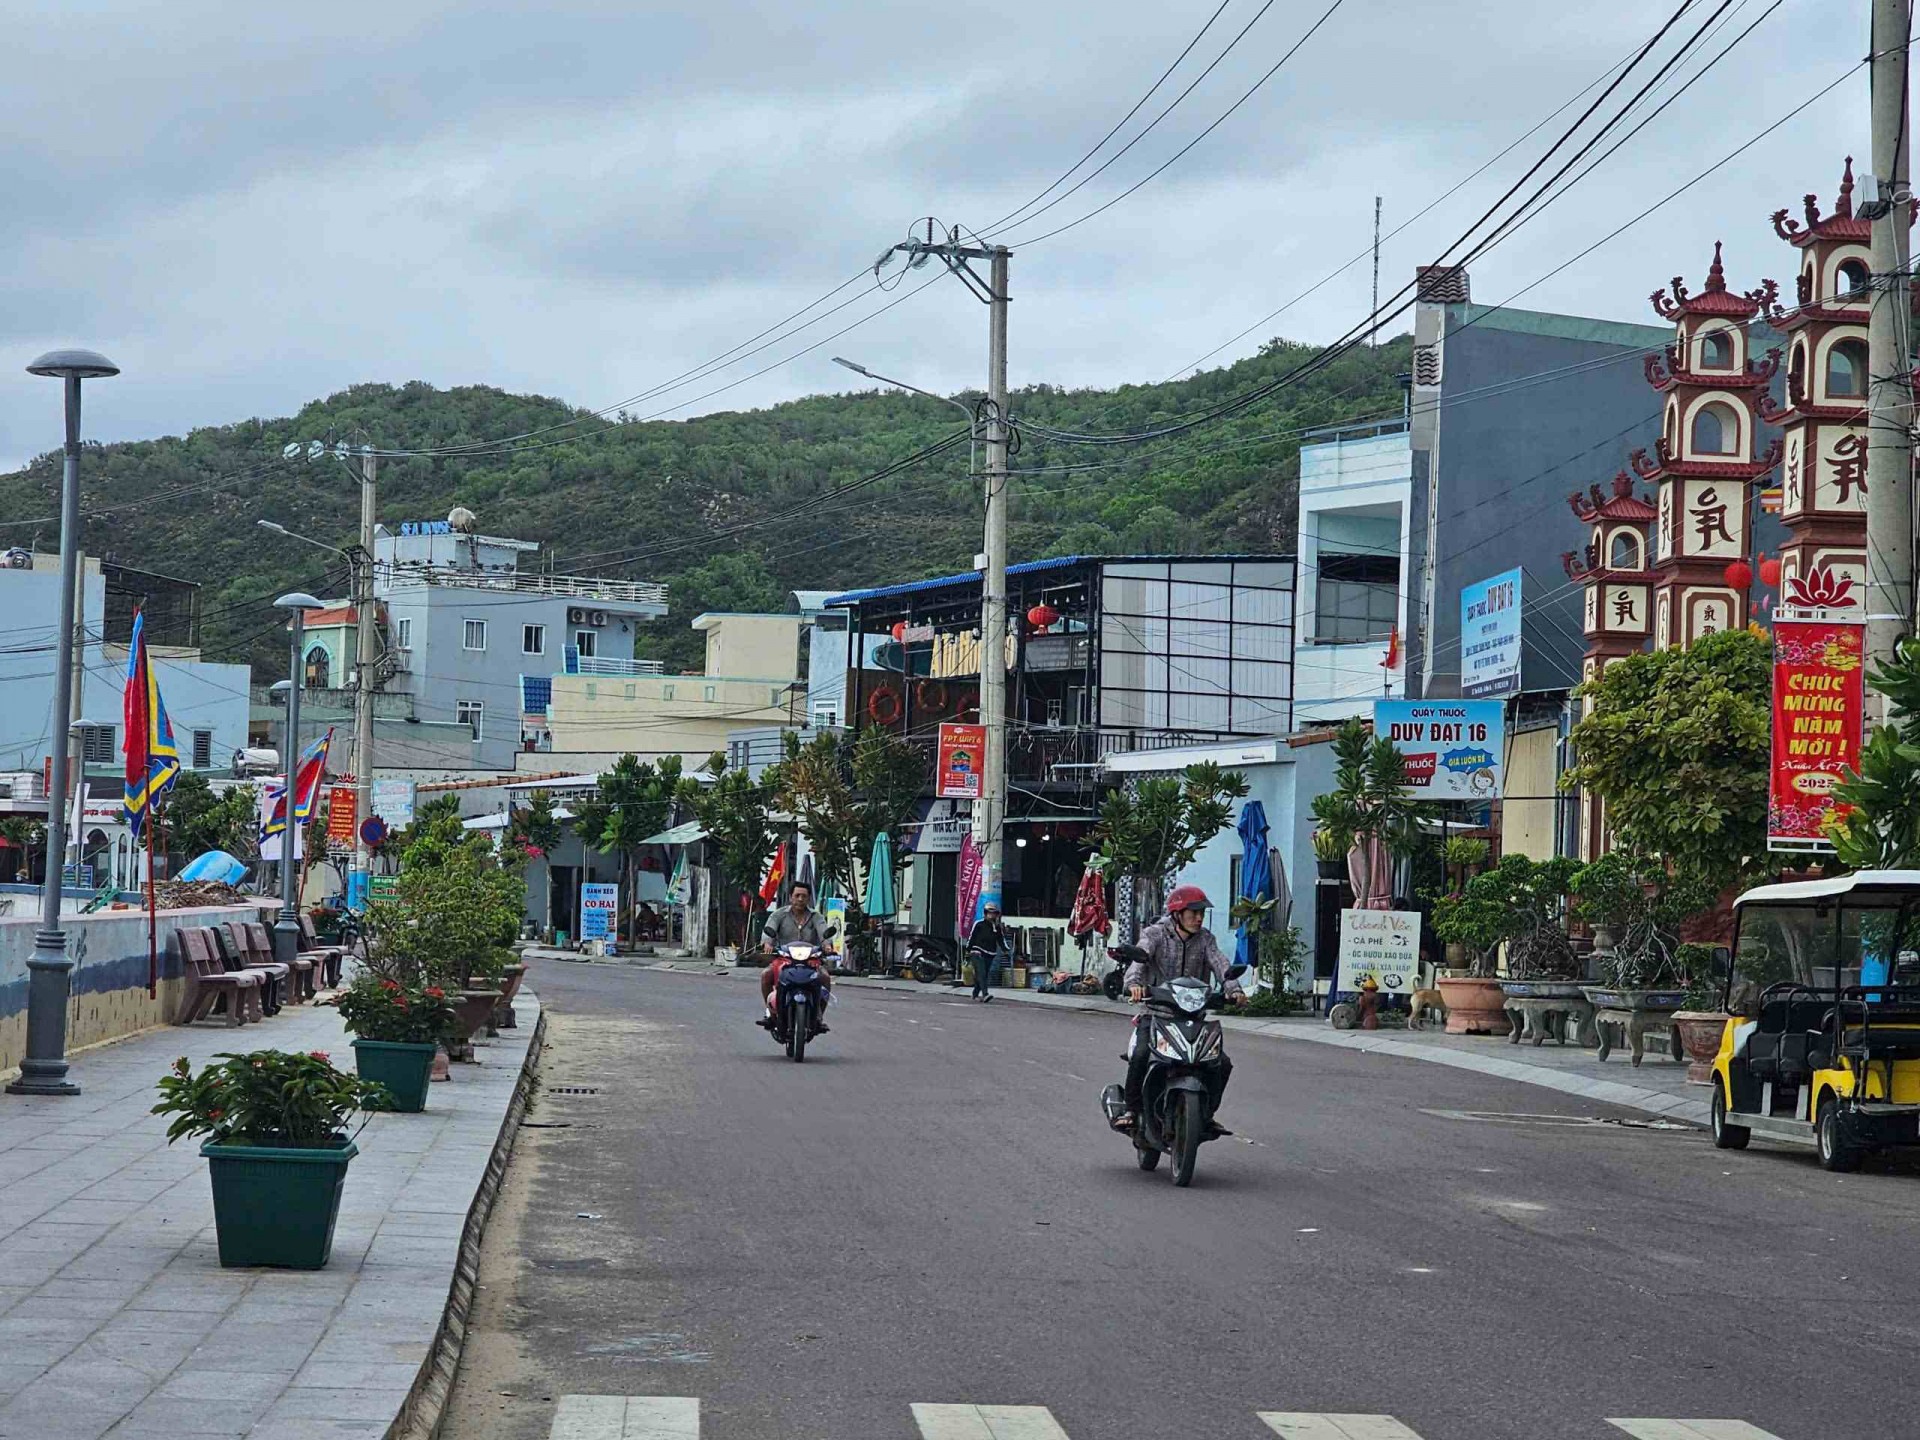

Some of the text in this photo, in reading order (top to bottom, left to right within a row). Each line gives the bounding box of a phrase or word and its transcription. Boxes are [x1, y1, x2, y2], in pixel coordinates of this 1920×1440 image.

[1788, 673, 1845, 691] CHÚC
[1783, 693, 1846, 712] MỪNG
[1390, 722, 1487, 746] DUY ĐẠT 16
[1793, 716, 1843, 734] NĂM
[1788, 738, 1848, 756] MỚI !
[1780, 760, 1812, 771] Xuân
[598, 900, 615, 909] HAI
